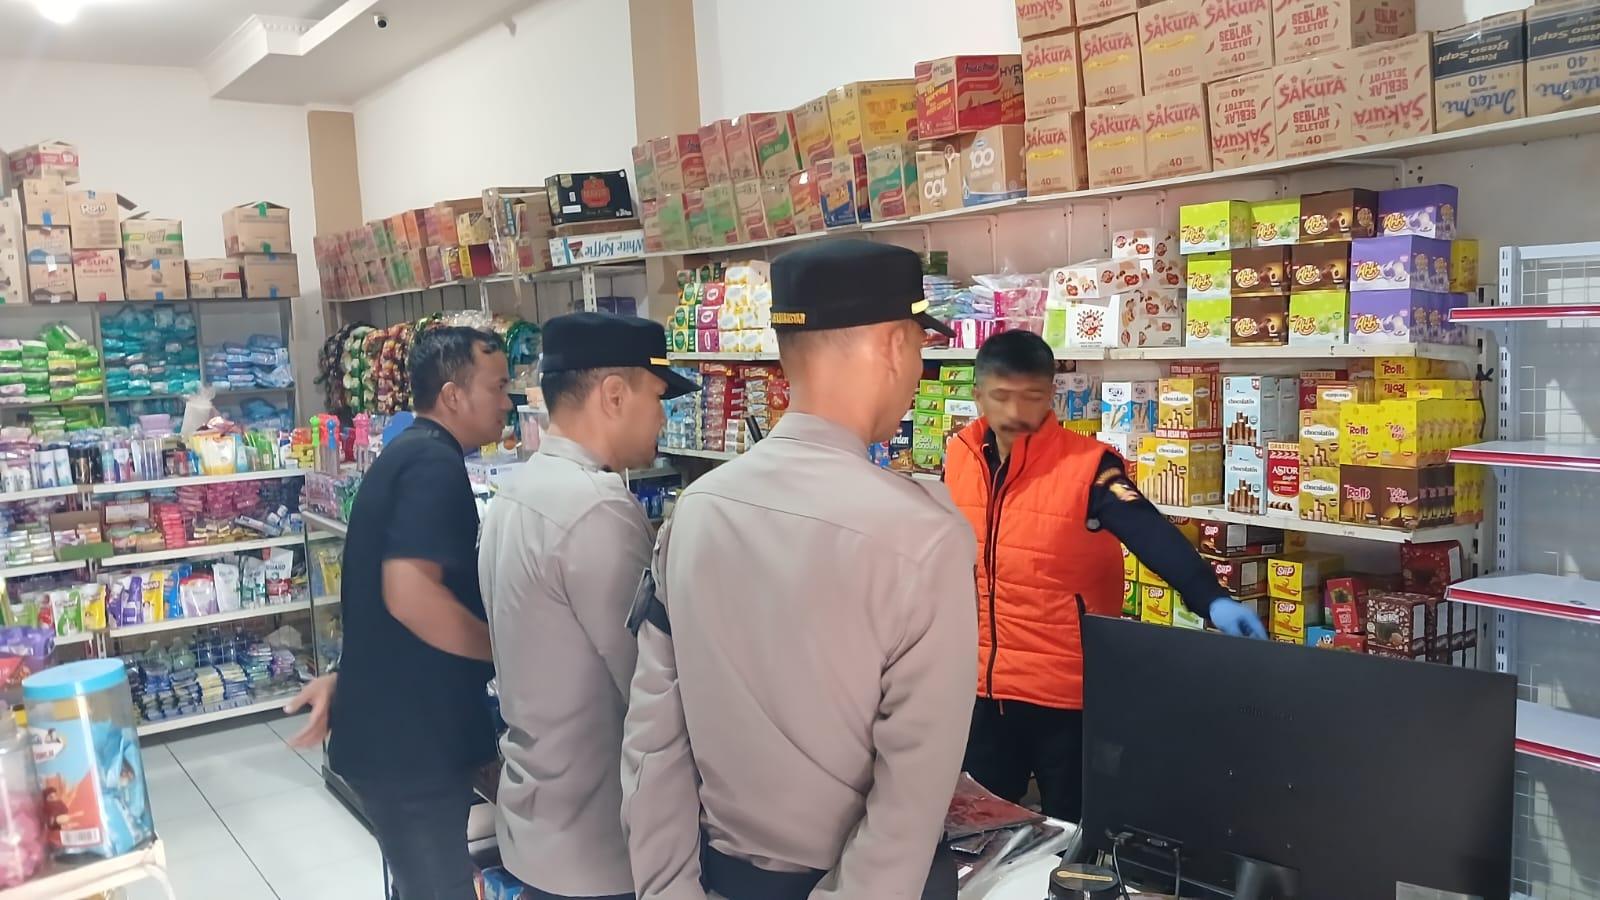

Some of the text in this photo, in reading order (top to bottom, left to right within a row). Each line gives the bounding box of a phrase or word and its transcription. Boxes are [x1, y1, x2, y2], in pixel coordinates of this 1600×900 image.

[1292, 6, 1329, 25] SEBLAK
[1219, 23, 1253, 42] SEBLAK
[1304, 35, 1321, 47] 40
[1231, 52, 1246, 64] 40
[1567, 56, 1588, 69] 40
[1168, 67, 1182, 78] 40
[1468, 74, 1487, 87] 40
[1104, 86, 1116, 96] 40
[1044, 96, 1057, 106] 40
[1293, 103, 1331, 123] SEBLAK
[1305, 134, 1322, 146] 40
[1168, 156, 1183, 168] 40
[1110, 165, 1123, 176] 40
[1040, 176, 1052, 186] 40
[1383, 362, 1405, 375] Rolls
[1349, 424, 1369, 436] Rolls
[1272, 465, 1299, 476] ASTOR
[1345, 486, 1371, 501] Rolls
